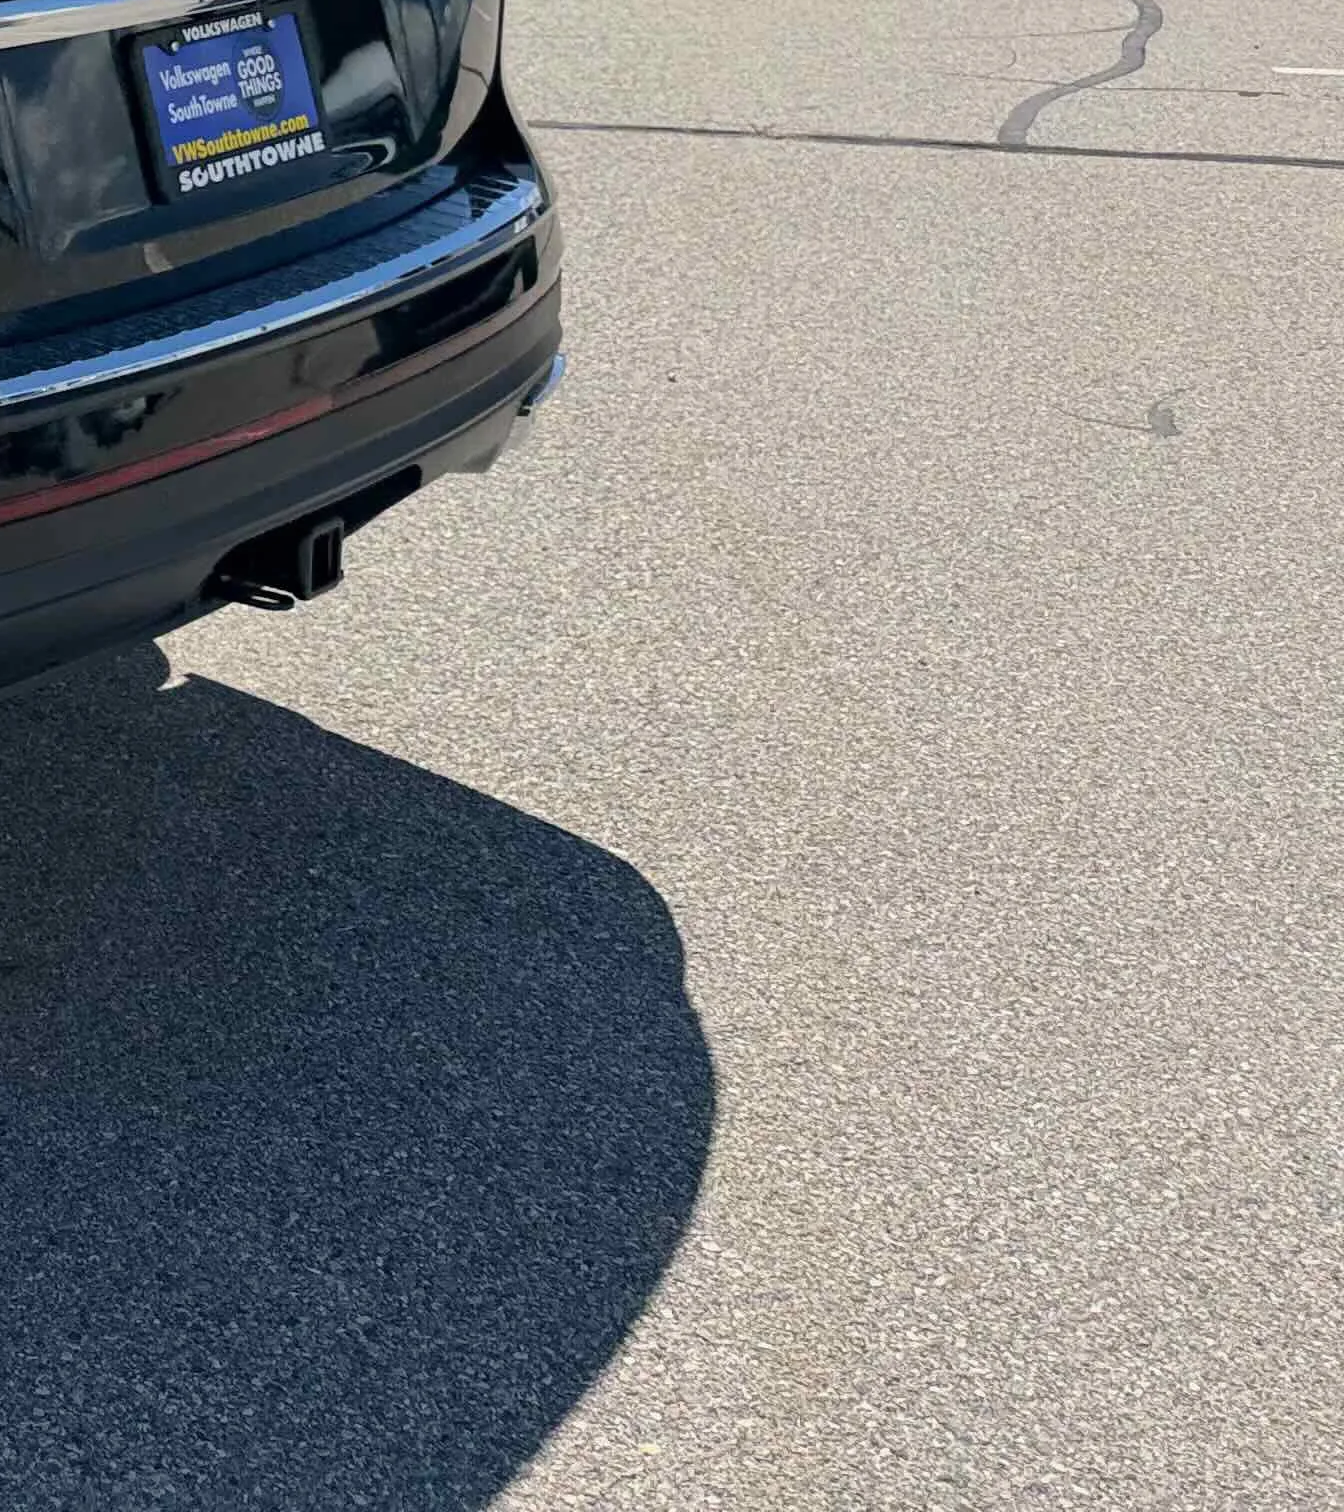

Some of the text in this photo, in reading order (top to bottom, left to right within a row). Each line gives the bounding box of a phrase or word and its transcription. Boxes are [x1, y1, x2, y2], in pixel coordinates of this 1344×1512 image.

[182, 12, 263, 43] VOLKSWAGEN
[159, 61, 231, 92] Volkswagen
[237, 54, 275, 80] GOOD
[238, 72, 282, 99] THINGS
[168, 93, 238, 124] SouthTowne
[171, 114, 309, 165] VWSouthtowne.com
[178, 131, 326, 192] SOUTHTOWNE
